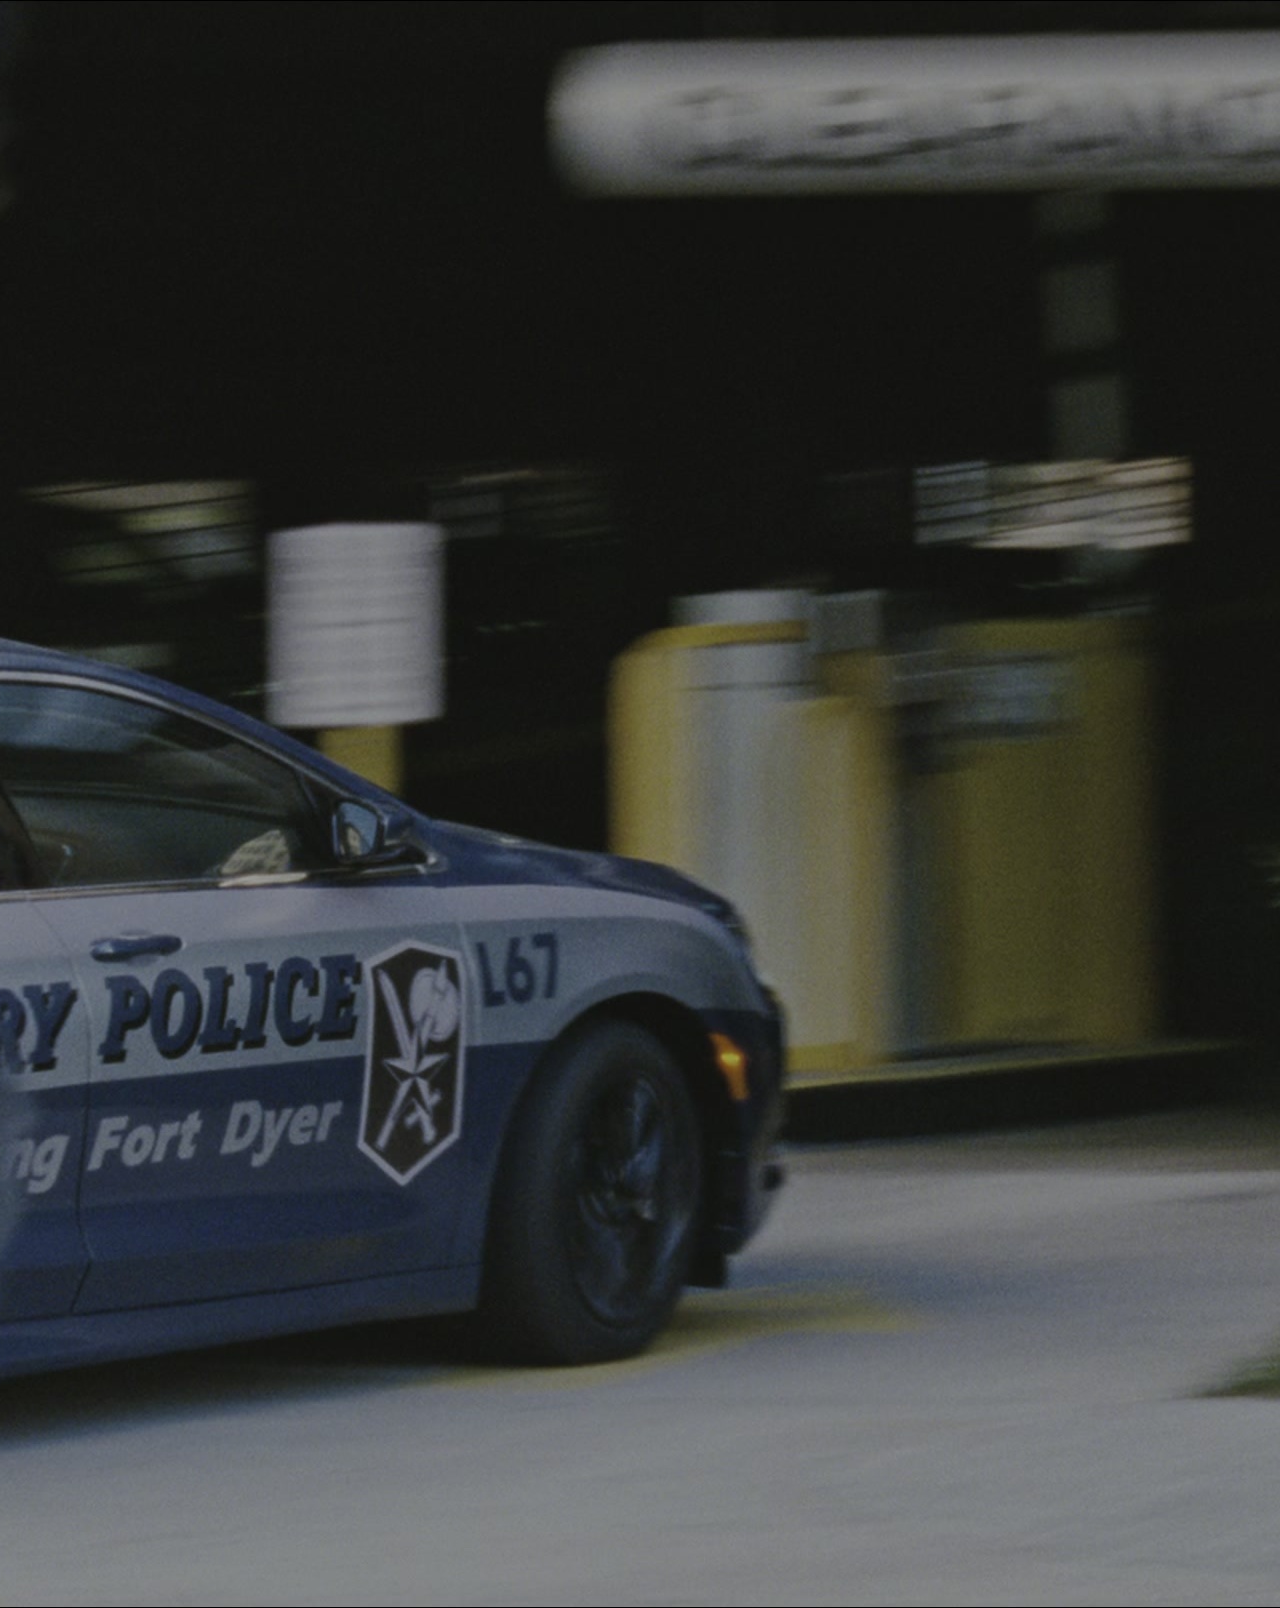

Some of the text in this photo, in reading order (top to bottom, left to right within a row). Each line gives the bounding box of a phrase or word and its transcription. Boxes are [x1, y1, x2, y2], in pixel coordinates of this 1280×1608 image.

[99, 953, 363, 1064] POLICE
[475, 931, 560, 1007] L67
[0, 1098, 345, 1195] ng Fort Dyer
